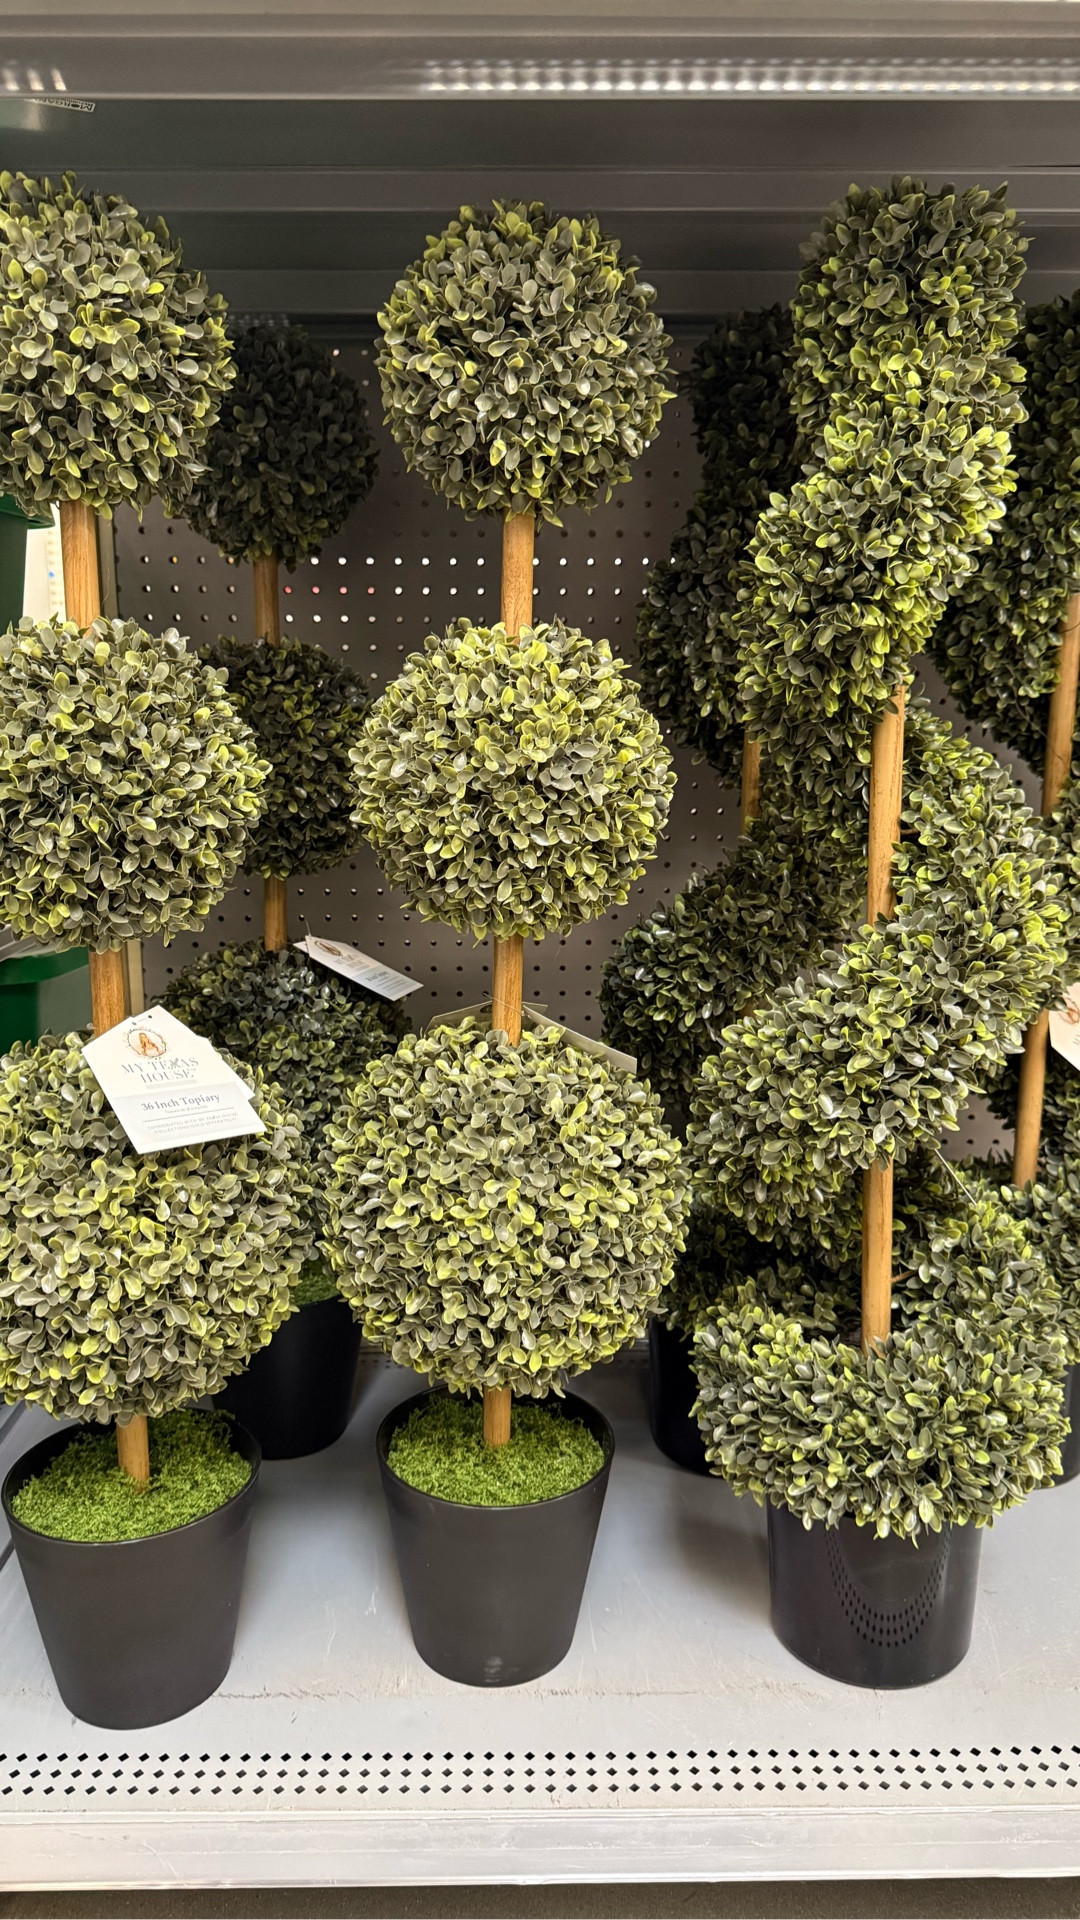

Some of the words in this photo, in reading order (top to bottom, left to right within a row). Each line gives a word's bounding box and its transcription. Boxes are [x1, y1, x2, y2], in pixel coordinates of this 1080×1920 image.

[121, 1063, 143, 1073] MY
[147, 1057, 199, 1071] TEXAS
[140, 1070, 194, 1083] HOUSE
[141, 1102, 154, 1111] 36
[154, 1098, 180, 1110] Inch
[179, 1093, 221, 1106] Topiary
